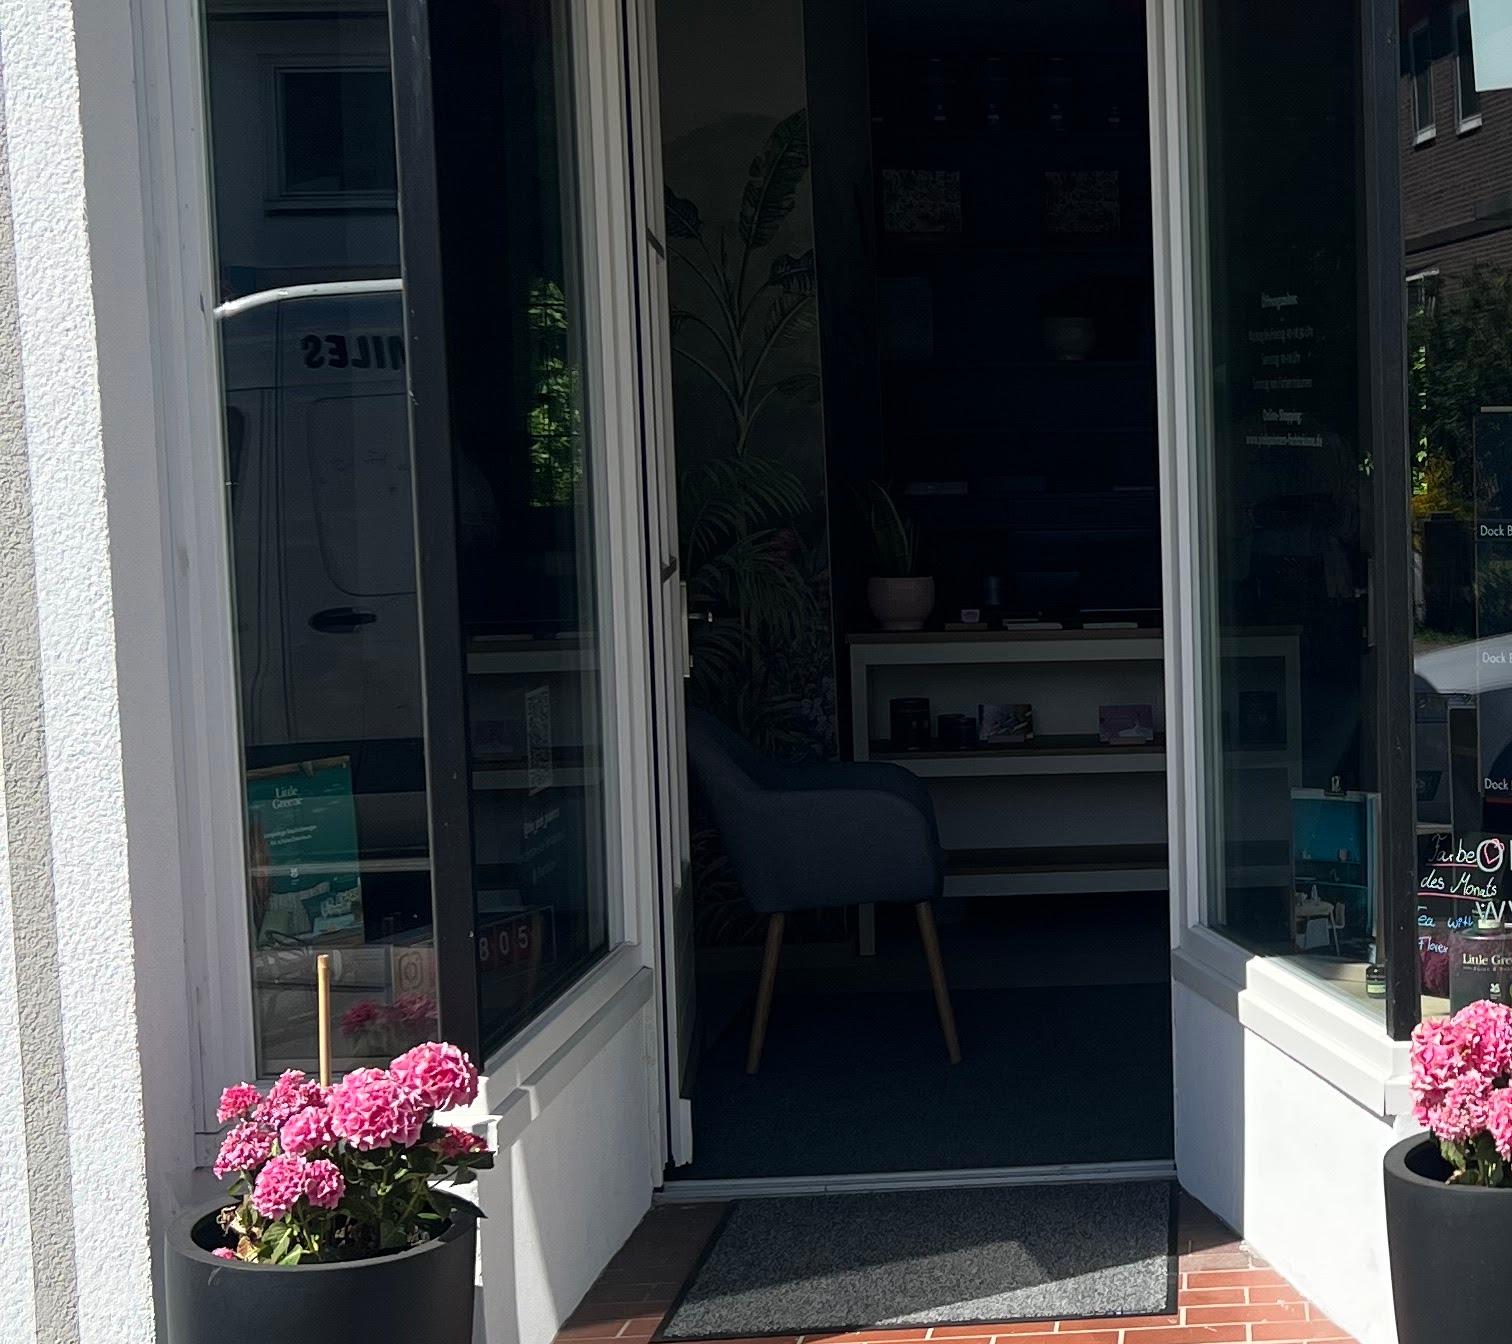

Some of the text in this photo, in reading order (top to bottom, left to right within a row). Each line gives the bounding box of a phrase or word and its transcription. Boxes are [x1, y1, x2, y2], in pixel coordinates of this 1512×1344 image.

[1480, 524, 1504, 537] Dock
[1482, 651, 1505, 664] Dock
[1484, 777, 1509, 792] Dock
[1428, 833, 1478, 864] Farbe
[1419, 869, 1498, 898] des Monats
[1462, 953, 1488, 966] Little
